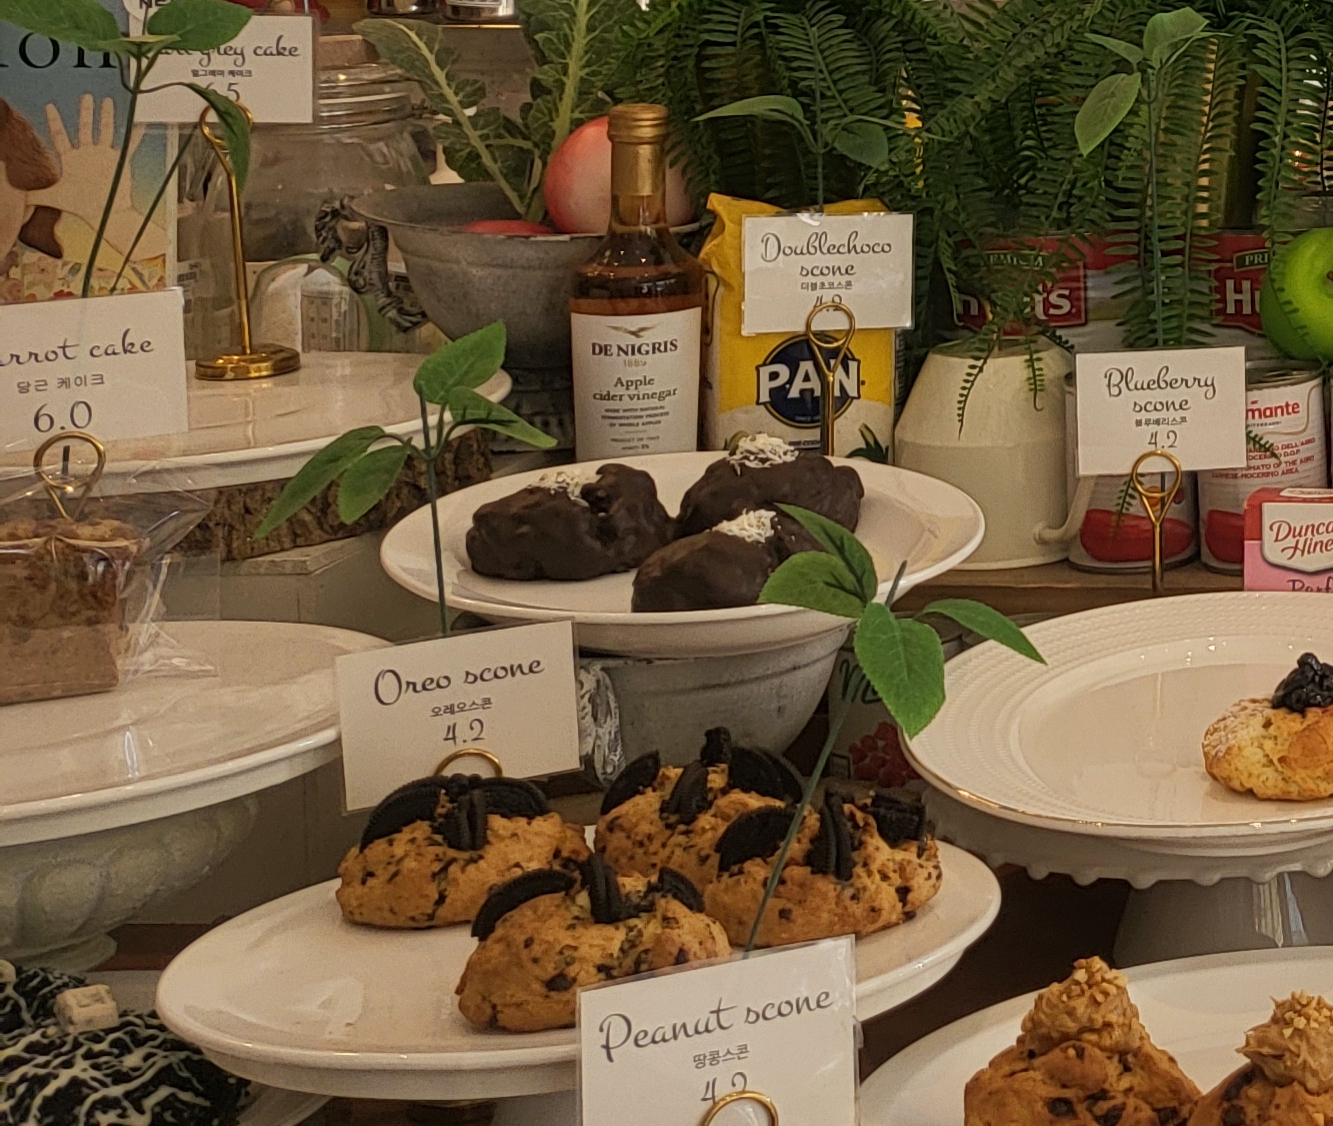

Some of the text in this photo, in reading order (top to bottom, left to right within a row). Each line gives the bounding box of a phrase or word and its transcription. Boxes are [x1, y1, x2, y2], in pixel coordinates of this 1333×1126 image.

[252, 34, 301, 58] cake
[760, 230, 892, 263] Doublechoco
[799, 262, 856, 278] scone
[0, 327, 155, 367] rrot cake
[591, 338, 679, 357] DE NIGRIS
[16, 373, 105, 394] 당근 케이크
[592, 387, 678, 402] cider vinegar
[613, 375, 656, 391] Apple
[1104, 365, 1217, 400] Blueberry
[33, 400, 93, 433] 6.0
[1132, 398, 1192, 414] scone
[1147, 429, 1178, 450] 4.2
[373, 655, 546, 707] Oreo scone
[429, 694, 494, 720] 오레오스콘
[441, 719, 486, 746] 4.2
[598, 987, 834, 1064] Peanut scone
[692, 1043, 751, 1072] 땅콩스콘
